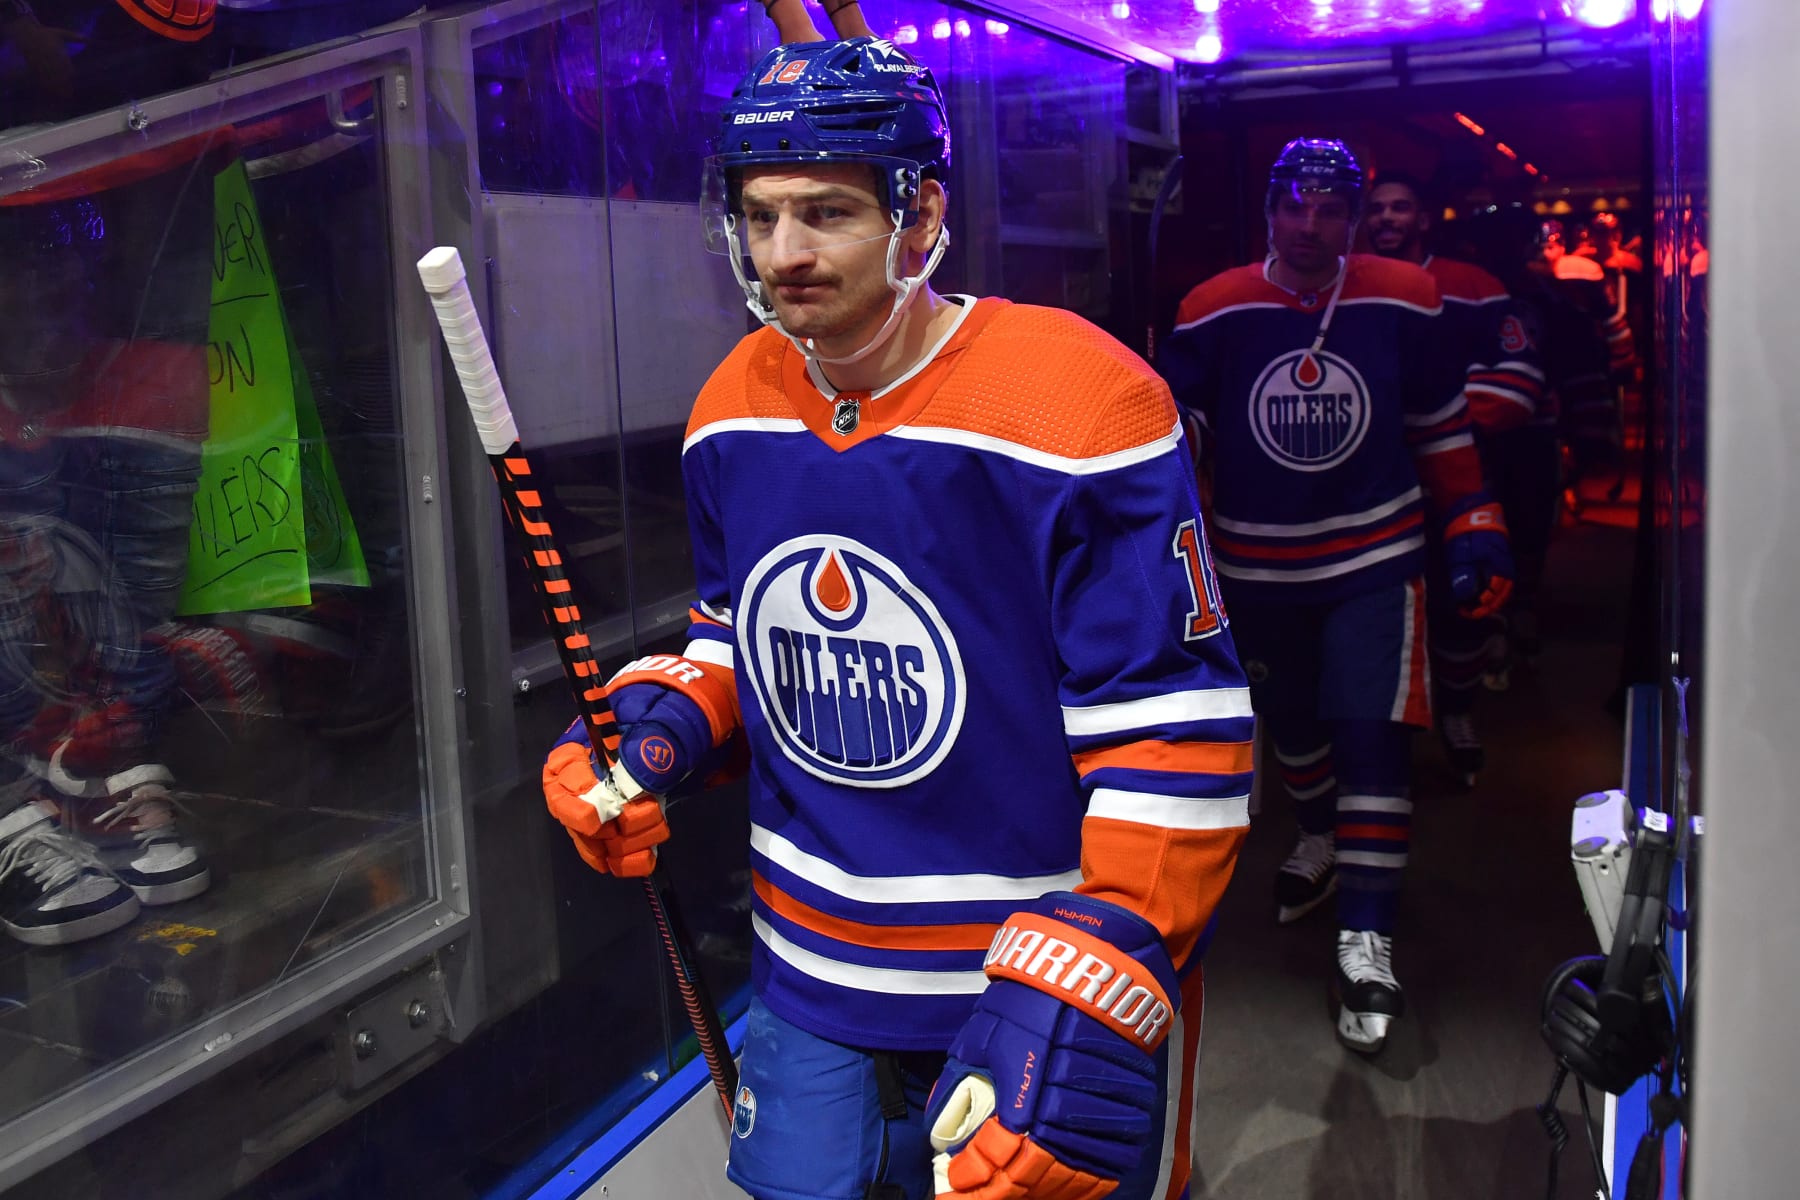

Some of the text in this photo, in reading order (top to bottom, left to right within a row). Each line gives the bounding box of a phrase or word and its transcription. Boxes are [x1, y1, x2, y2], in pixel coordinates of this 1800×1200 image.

[733, 110, 794, 125] BAUER
[1266, 393, 1353, 460] OILERS
[768, 625, 928, 769] OILERS
[1053, 907, 1104, 928] HYMAN
[1013, 1050, 1037, 1110] ALPHA
